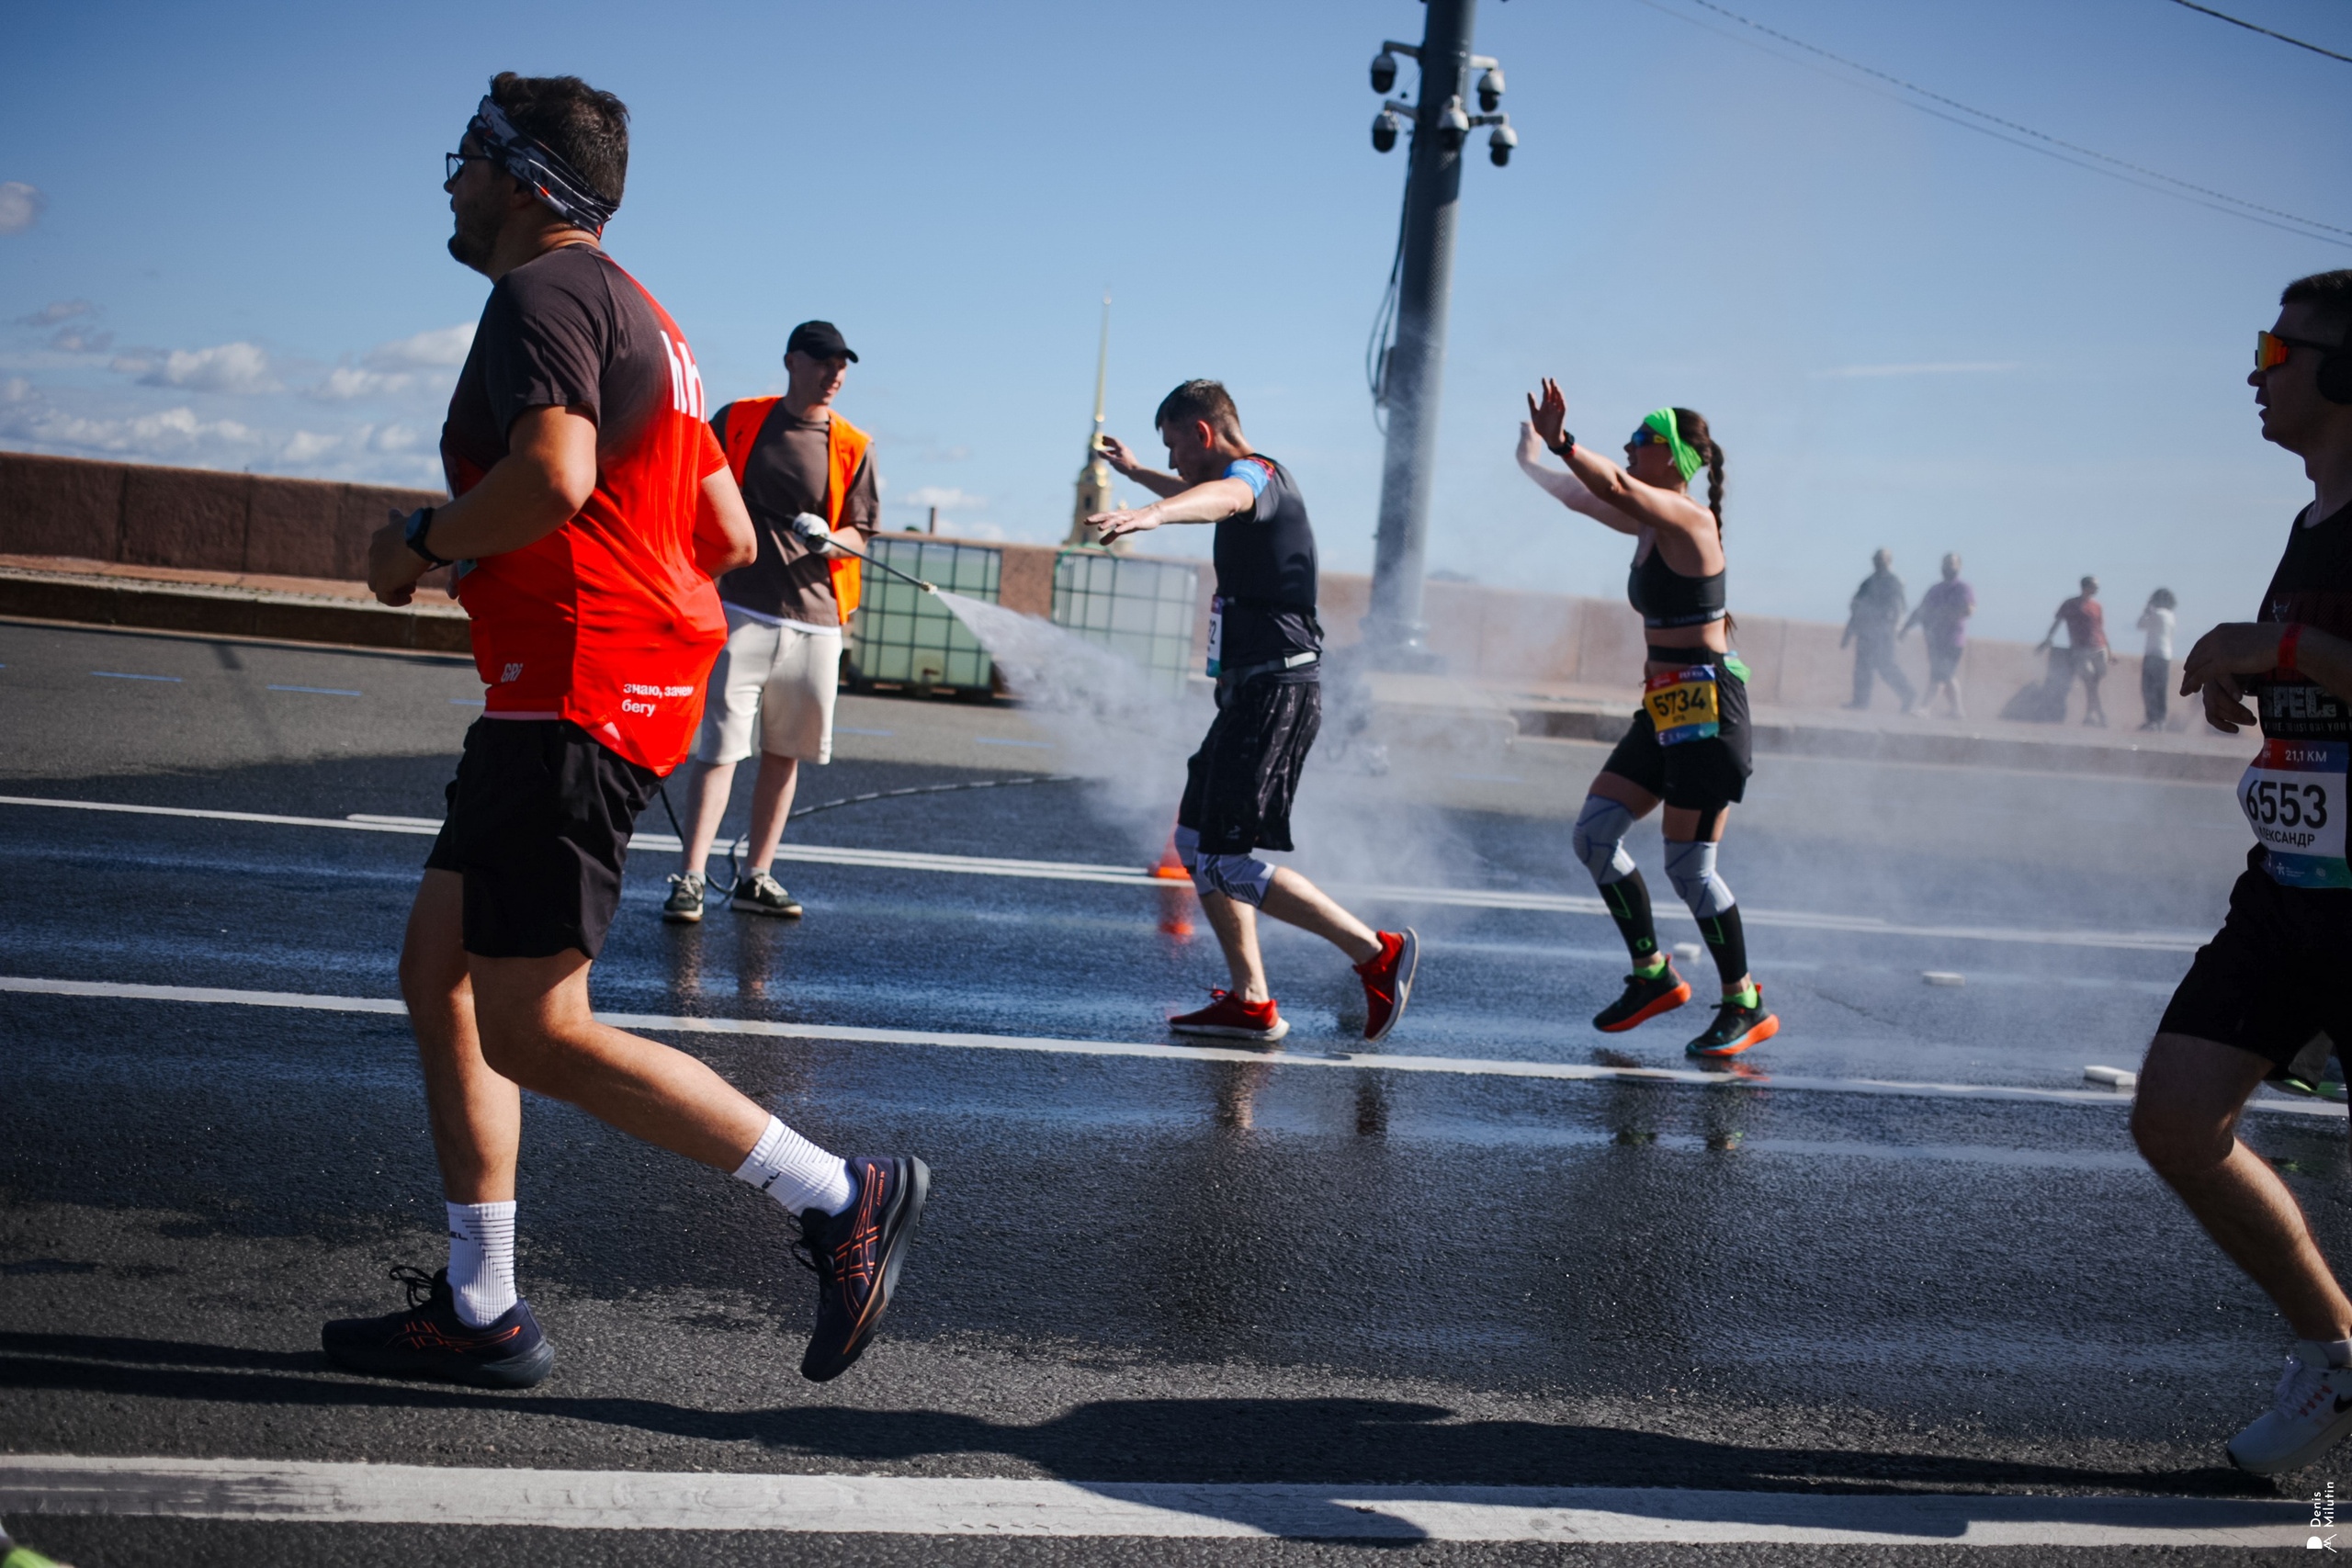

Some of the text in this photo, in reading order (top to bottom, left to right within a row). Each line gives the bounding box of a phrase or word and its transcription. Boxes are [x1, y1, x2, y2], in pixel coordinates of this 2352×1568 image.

[623, 683, 662, 699] знаю,
[622, 698, 656, 717] бегу
[1654, 687, 1706, 716] 5734
[2285, 750, 2304, 763] 21,1
[2246, 779, 2327, 829] 6553
